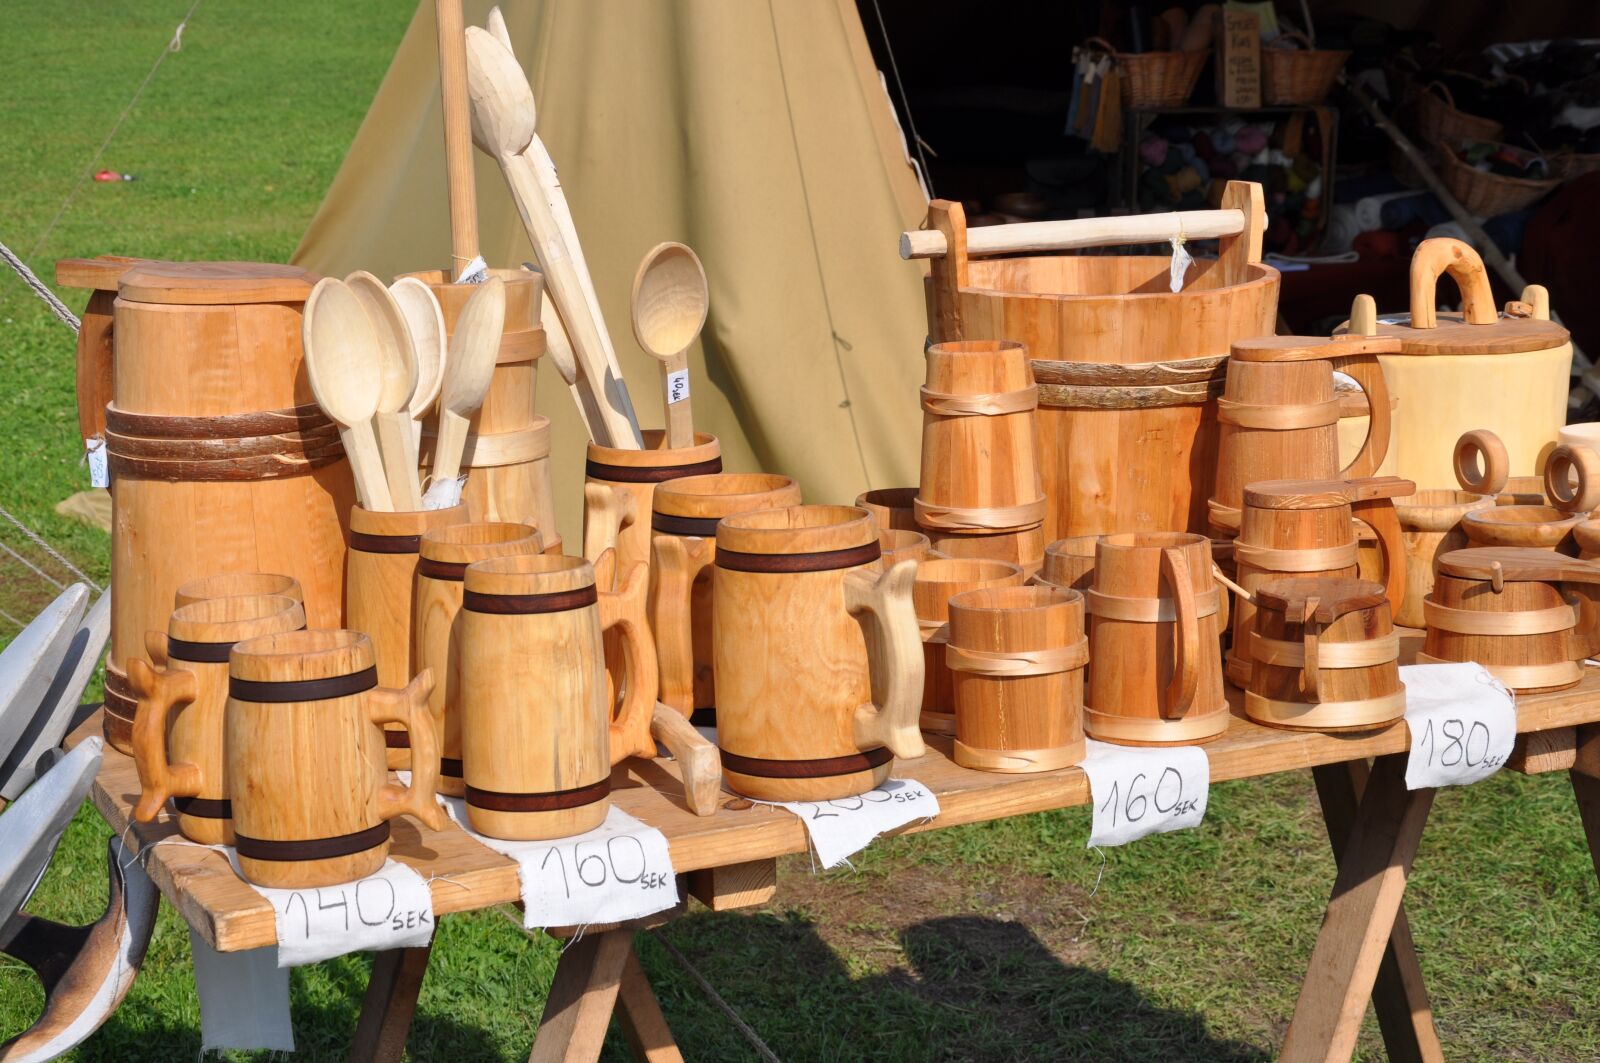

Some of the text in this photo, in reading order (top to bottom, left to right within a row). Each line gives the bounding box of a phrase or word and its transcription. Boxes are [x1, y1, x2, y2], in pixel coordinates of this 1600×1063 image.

[673, 377, 685, 389] 40
[1420, 718, 1504, 769] 180 SEK
[894, 790, 925, 803] SEK
[1101, 766, 1199, 828] 160 SEK
[541, 835, 668, 899] 160 SEK
[285, 877, 431, 939] 140 SEK
